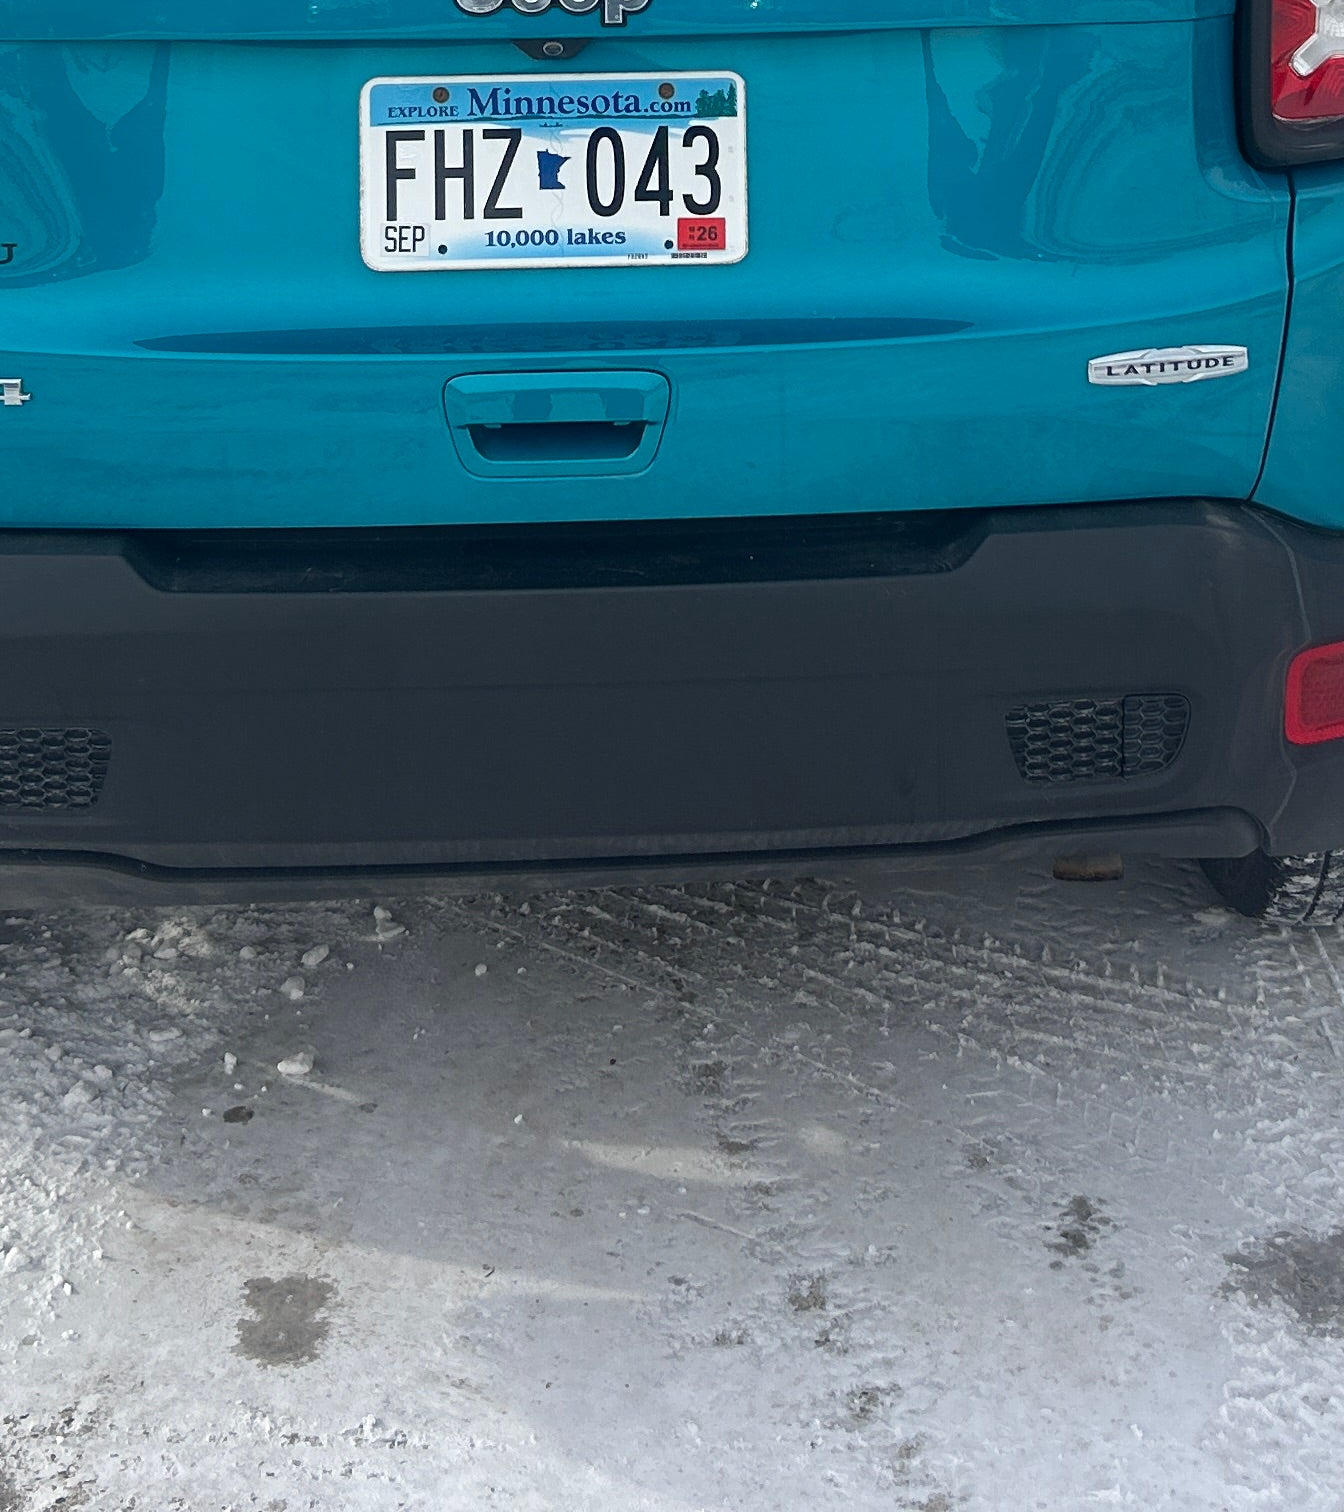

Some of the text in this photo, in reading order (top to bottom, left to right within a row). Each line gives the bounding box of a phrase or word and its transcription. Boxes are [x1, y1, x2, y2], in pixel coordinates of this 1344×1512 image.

[387, 87, 692, 118] EXPLORE Minnesota.com
[385, 125, 722, 221] FHZ 043
[384, 225, 426, 253] SEP
[484, 228, 627, 249] 10,000 lakes
[696, 225, 718, 241] 26
[1106, 355, 1235, 377] LATITUDE
